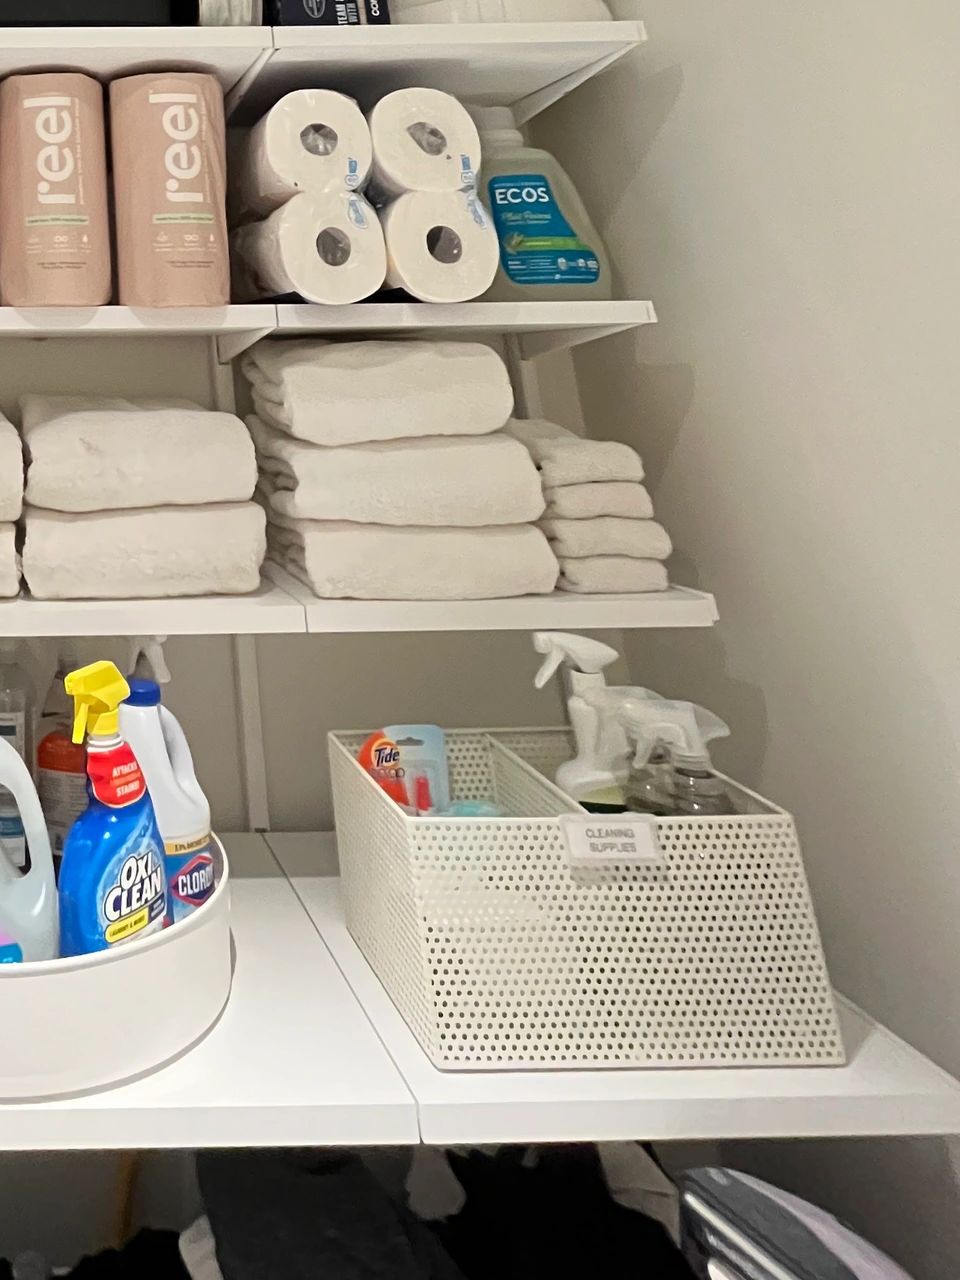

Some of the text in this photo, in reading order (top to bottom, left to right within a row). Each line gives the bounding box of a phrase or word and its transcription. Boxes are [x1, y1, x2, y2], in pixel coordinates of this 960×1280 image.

[336, 3, 348, 25] TEAM
[346, 3, 358, 23] WITH
[23, 96, 76, 204] reel
[149, 93, 203, 202] reel
[495, 187, 550, 204] ECOS
[374, 746, 400, 767] Tide
[585, 828, 636, 839] CLEANING
[589, 842, 637, 853] SUPPLIES
[120, 852, 153, 889] OXI
[105, 868, 163, 922] CLEAN
